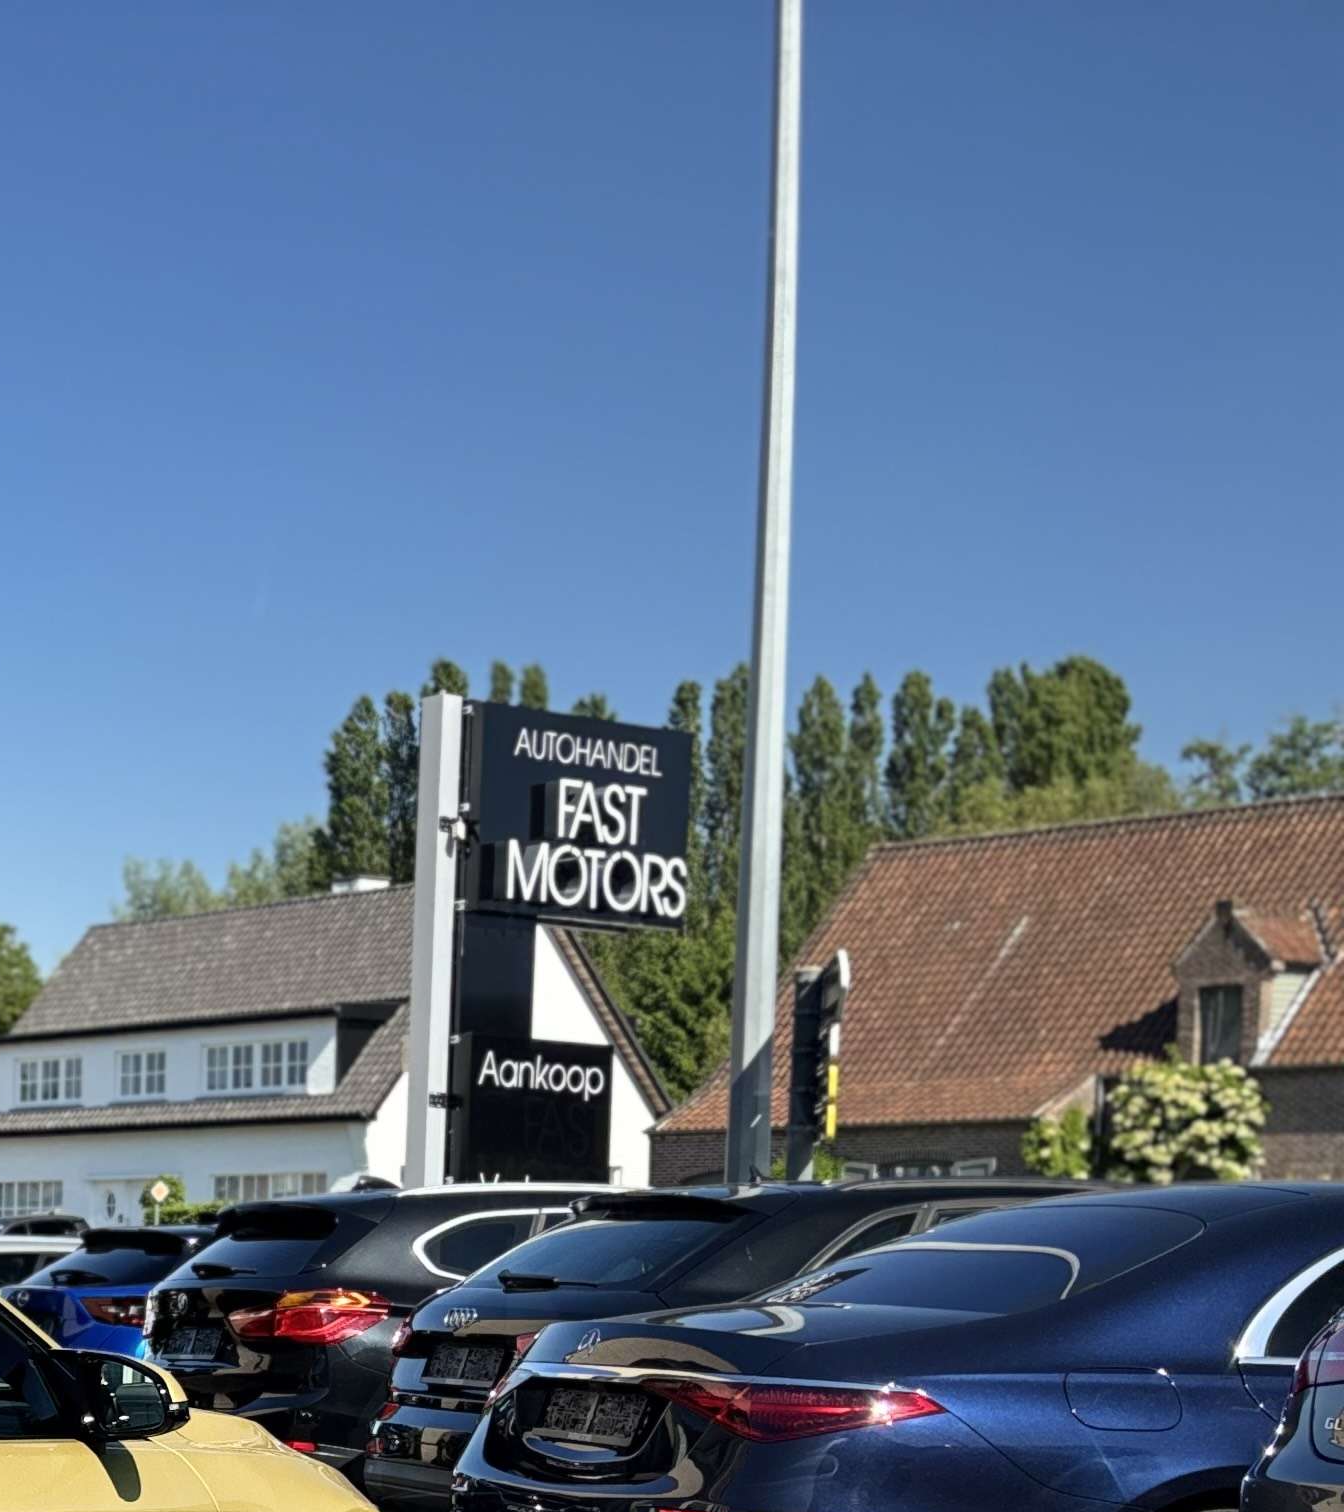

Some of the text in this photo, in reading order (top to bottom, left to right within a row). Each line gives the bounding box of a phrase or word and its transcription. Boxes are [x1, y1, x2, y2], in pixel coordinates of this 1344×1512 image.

[514, 728, 662, 776] AUTOHANDEL
[557, 778, 648, 845] FAST
[506, 838, 687, 918] MOTORS
[477, 1050, 605, 1102] Aankoop
